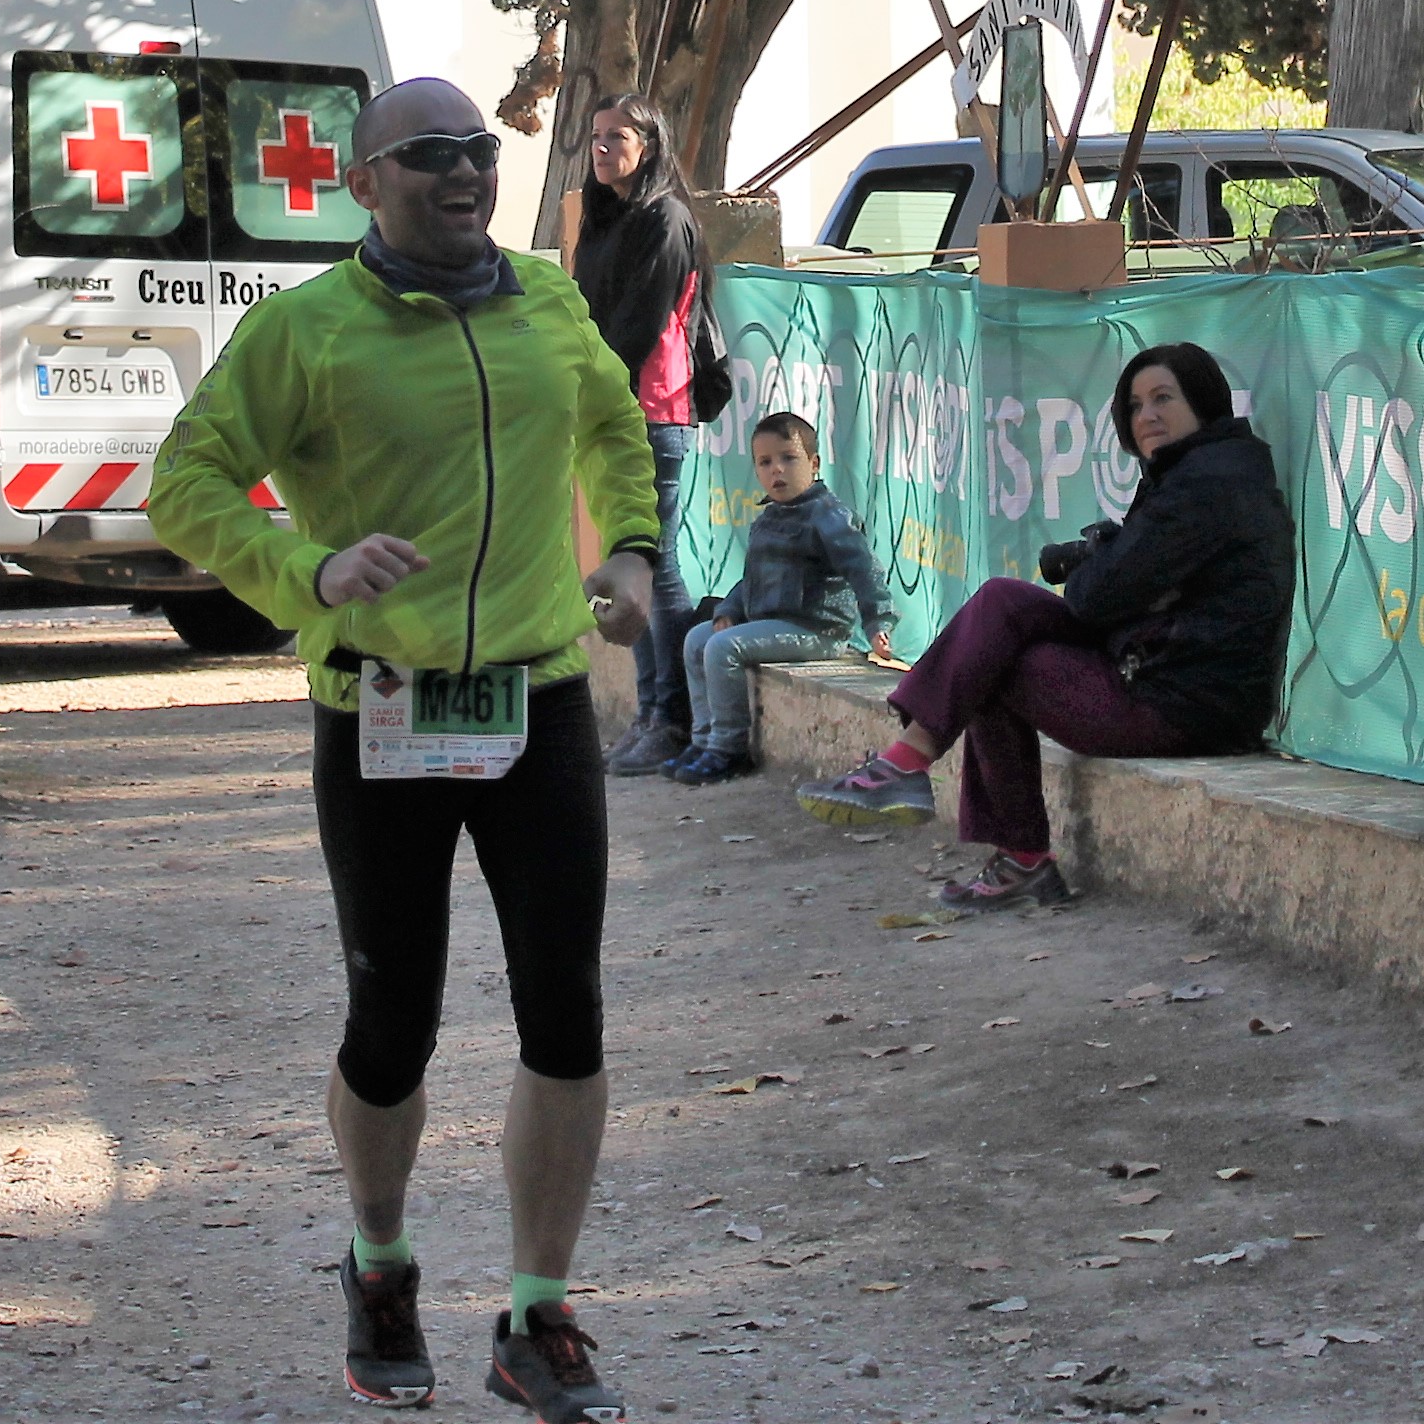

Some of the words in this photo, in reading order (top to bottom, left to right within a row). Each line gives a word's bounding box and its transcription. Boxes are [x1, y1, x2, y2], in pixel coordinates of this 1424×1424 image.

[33, 276, 113, 290] TRANSIT
[138, 269, 205, 304] Creu
[51, 368, 113, 395] 7854
[122, 368, 166, 395] GWB
[19, 437, 159, 455] moradebre@cruzr
[1378, 569, 1407, 641] la
[368, 716, 405, 728] SIRGA
